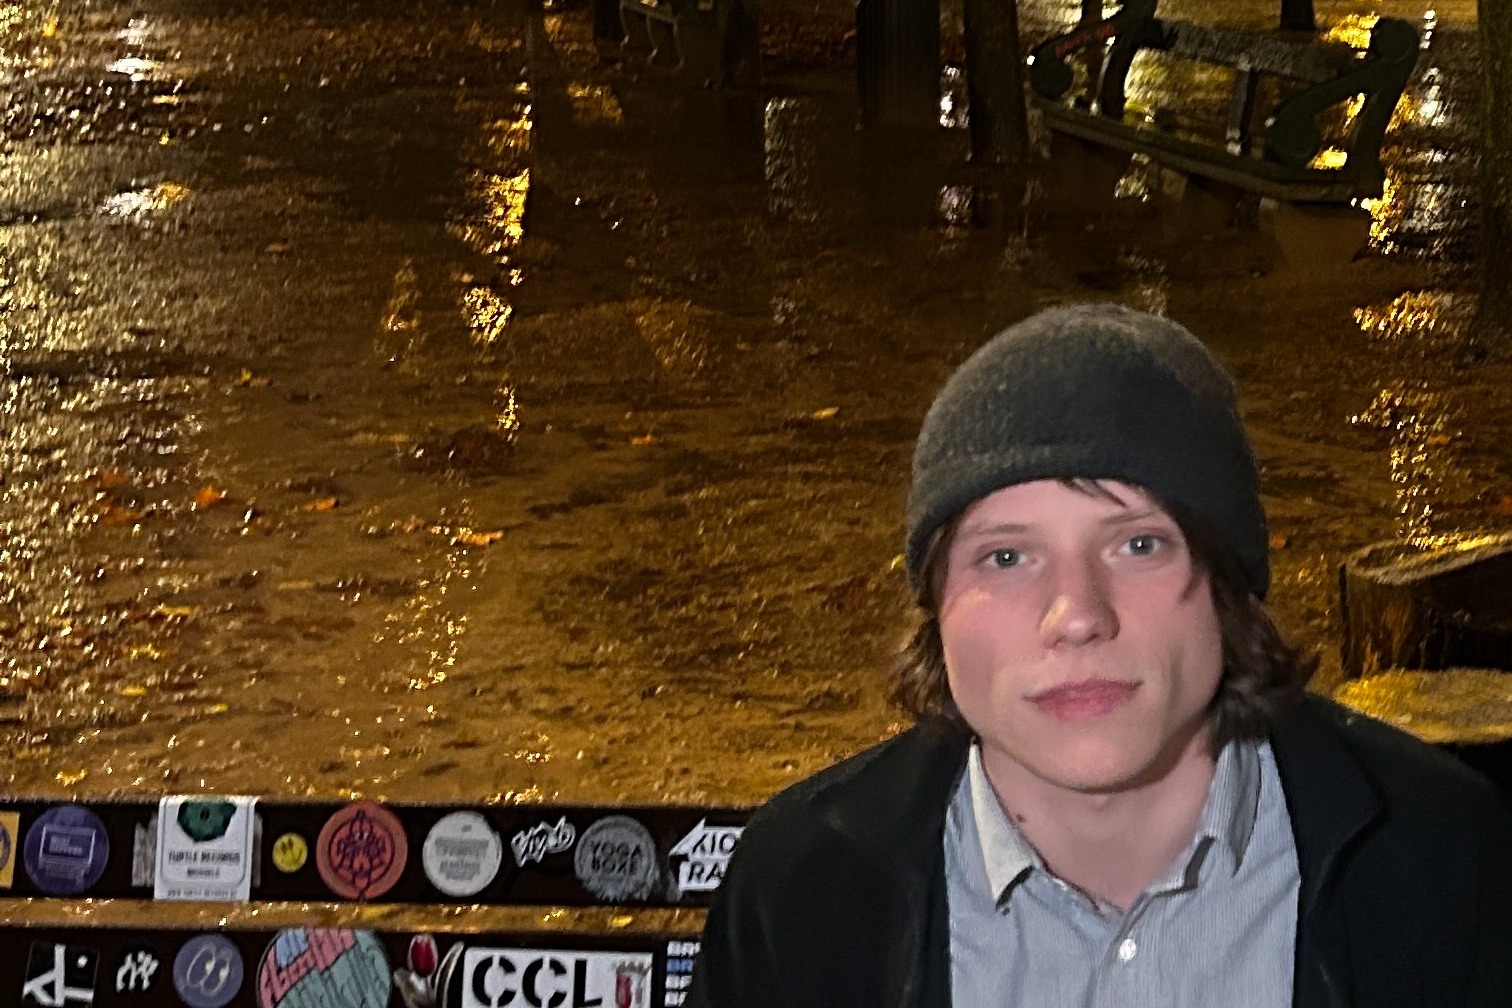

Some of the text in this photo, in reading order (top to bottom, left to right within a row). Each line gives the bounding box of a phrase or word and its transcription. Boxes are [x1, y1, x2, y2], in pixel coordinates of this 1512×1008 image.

[692, 833, 736, 854] KIO
[687, 861, 722, 882] RA
[472, 955, 603, 1008] CCL
